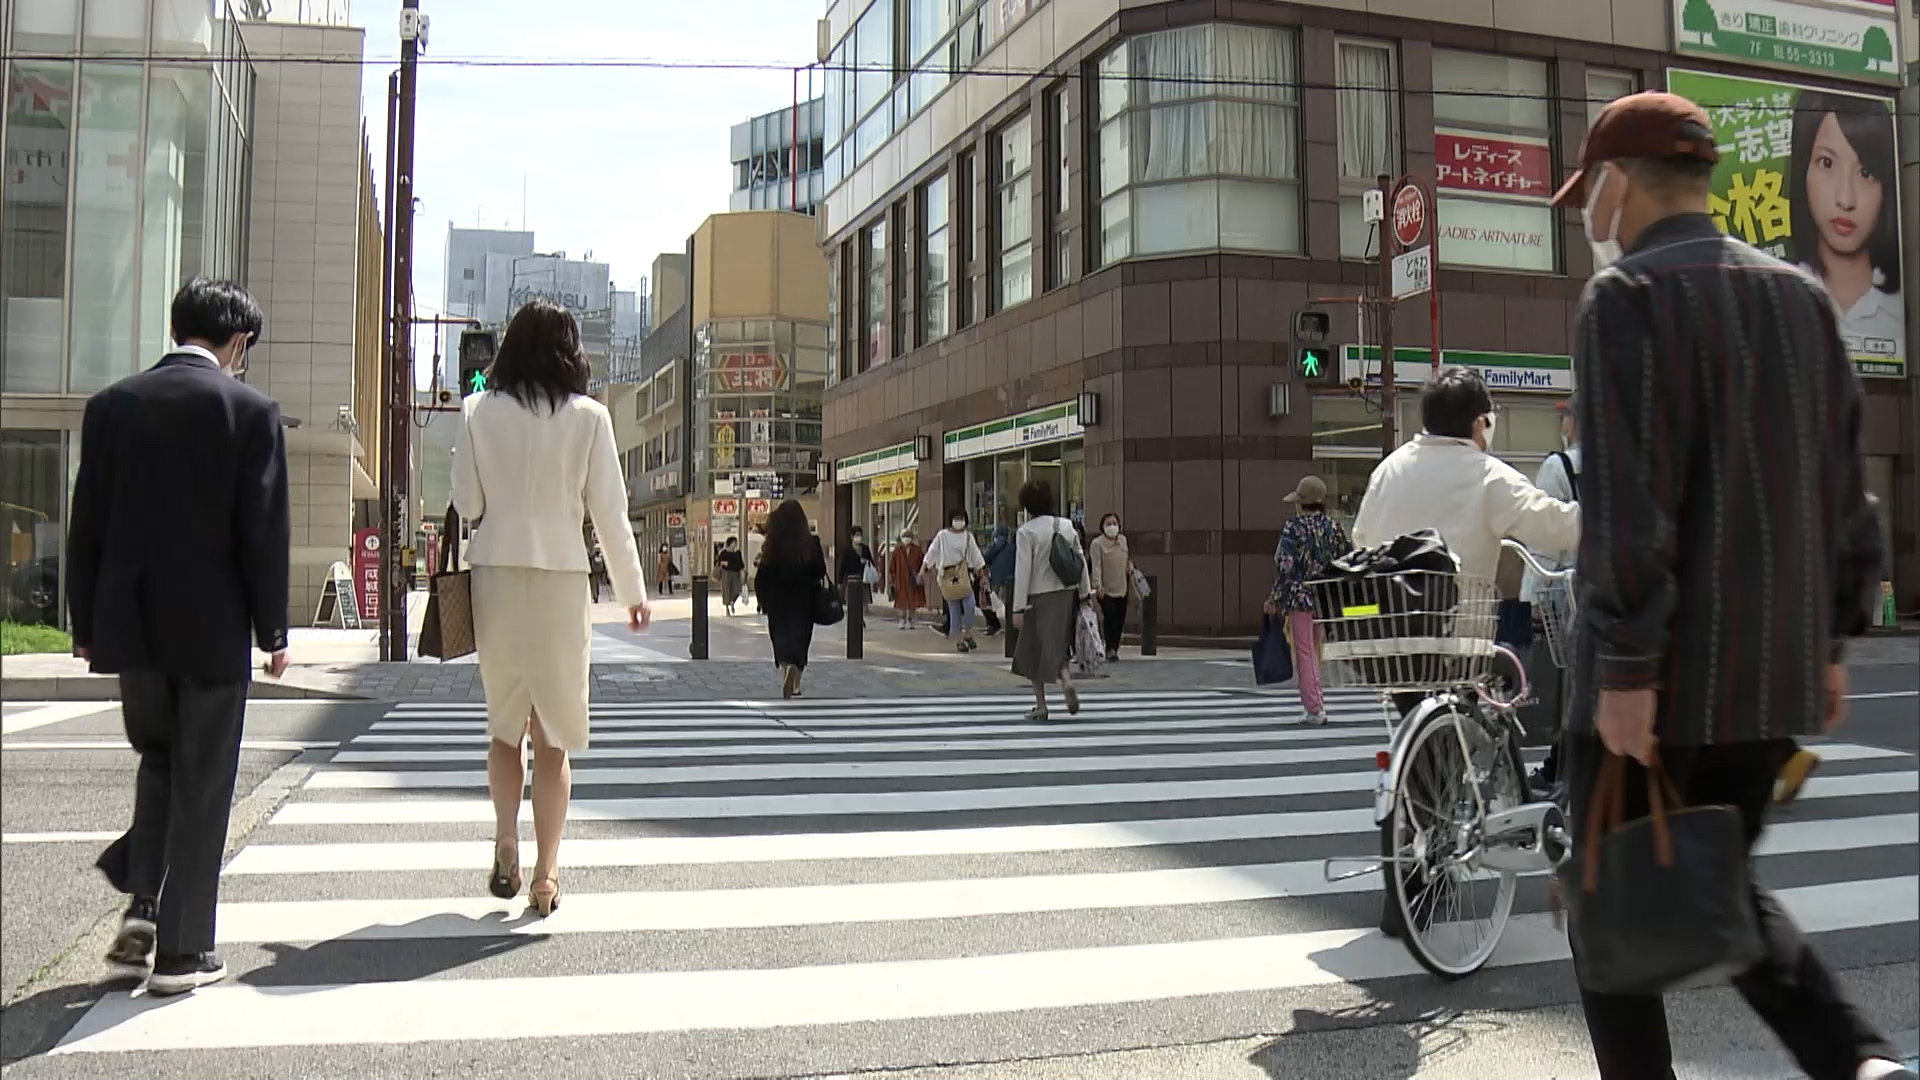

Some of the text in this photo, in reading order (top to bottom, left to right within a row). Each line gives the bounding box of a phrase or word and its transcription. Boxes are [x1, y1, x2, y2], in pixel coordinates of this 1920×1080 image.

[1749, 40, 1762, 57] 7F
[1454, 143, 1523, 166] レディース
[1436, 163, 1543, 189] アートネイチャー
[1396, 199, 1422, 231] 消火栓
[1438, 224, 1545, 248] LADIES ARTNATURE
[1484, 368, 1553, 387] FamilyMart
[1030, 422, 1059, 441] FamilyMart
